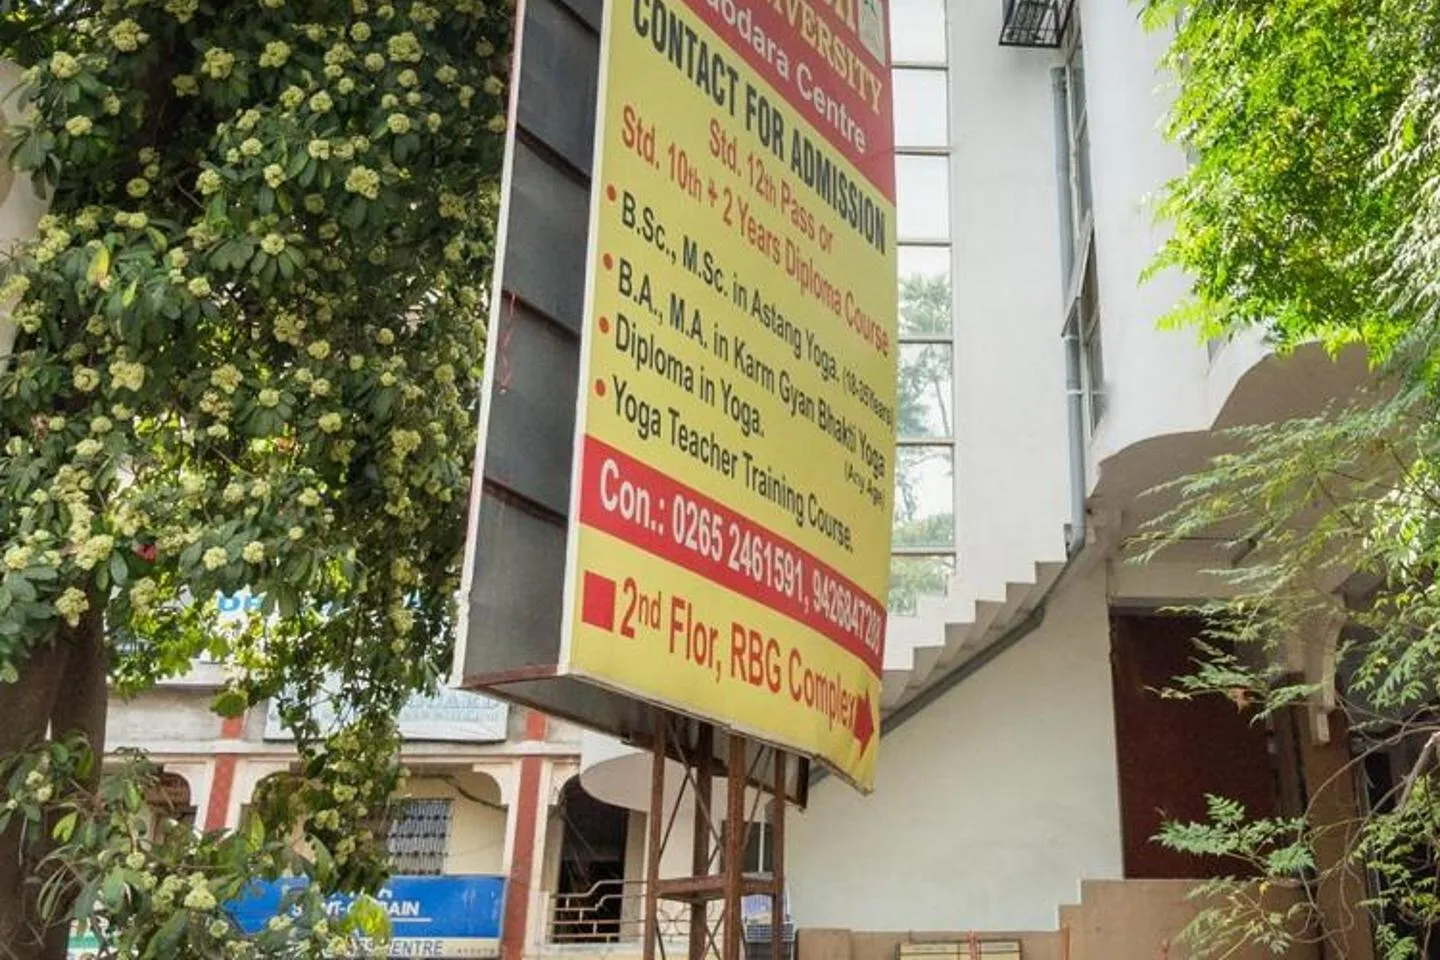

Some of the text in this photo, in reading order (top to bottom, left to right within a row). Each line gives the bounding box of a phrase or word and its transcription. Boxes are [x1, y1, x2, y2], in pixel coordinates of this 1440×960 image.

[709, 117, 742, 177] Std.
[747, 150, 777, 209] 12th
[780, 179, 815, 241] Pass
[746, 82, 785, 162] FOR
[791, 128, 886, 255] ADMISSION
[796, 62, 867, 154] Centre
[621, 104, 660, 171] Std.
[667, 141, 703, 203] 10th
[723, 187, 733, 228] 2
[737, 195, 781, 266] Years
[785, 236, 842, 317] Diploma
[845, 290, 890, 358] Course
[615, 312, 765, 438] Diploma in Yoga.
[683, 235, 728, 297] M.Sc.
[733, 272, 748, 312] in
[751, 288, 802, 360] Astang
[805, 328, 840, 383] Yoga.
[669, 292, 707, 349] M.A.
[713, 322, 728, 363] in
[734, 336, 775, 395] Karm
[779, 369, 816, 423] Gyan
[858, 427, 886, 480] Yoga
[600, 459, 665, 536] Con.:
[672, 493, 724, 562] 0265
[727, 522, 809, 614] 2461591,
[612, 374, 854, 554] Yoga Teacher Training Course.
[620, 576, 662, 639] 2nd
[669, 595, 722, 683] Flor,
[731, 621, 782, 694] RBG
[387, 940, 444, 956] ENTRE
